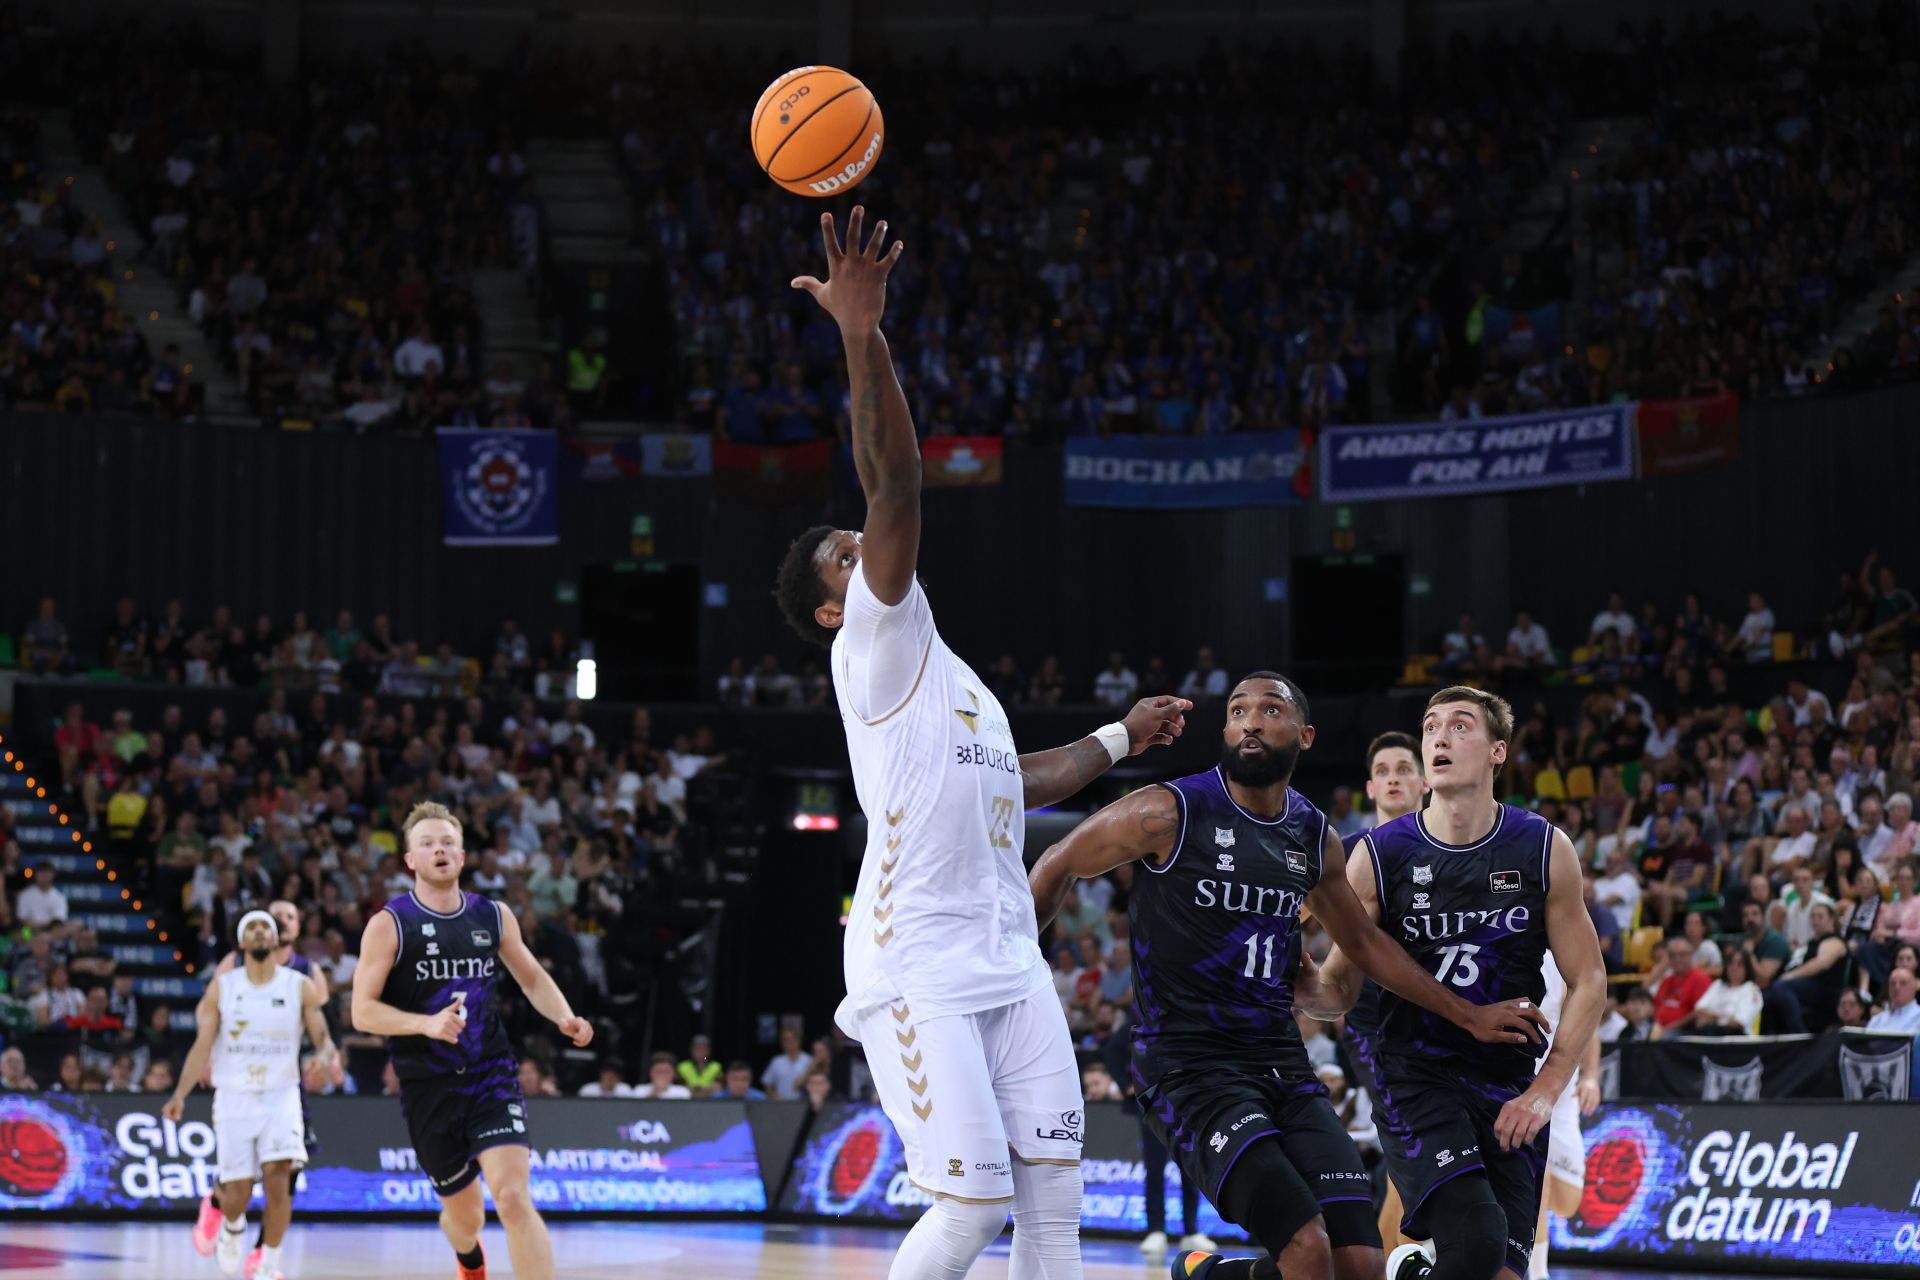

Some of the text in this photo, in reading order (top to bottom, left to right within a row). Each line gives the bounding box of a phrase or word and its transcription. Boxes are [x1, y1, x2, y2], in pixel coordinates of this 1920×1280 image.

[780, 86, 810, 111] acb
[809, 132, 881, 193] Wilson
[1337, 430, 1474, 461] ANDRÉS
[1409, 459, 1482, 485] POR
[974, 744, 1022, 776] BURG
[1402, 906, 1529, 942] surne
[416, 957, 495, 981] surne
[1244, 933, 1275, 978] 11
[115, 1112, 217, 1158] Glo
[1037, 1128, 1083, 1143] LEXU
[1231, 1122, 1243, 1131] EL
[1688, 1130, 1859, 1190] Global
[1320, 1172, 1370, 1181] NISSAN
[1666, 1187, 1832, 1243] datum
